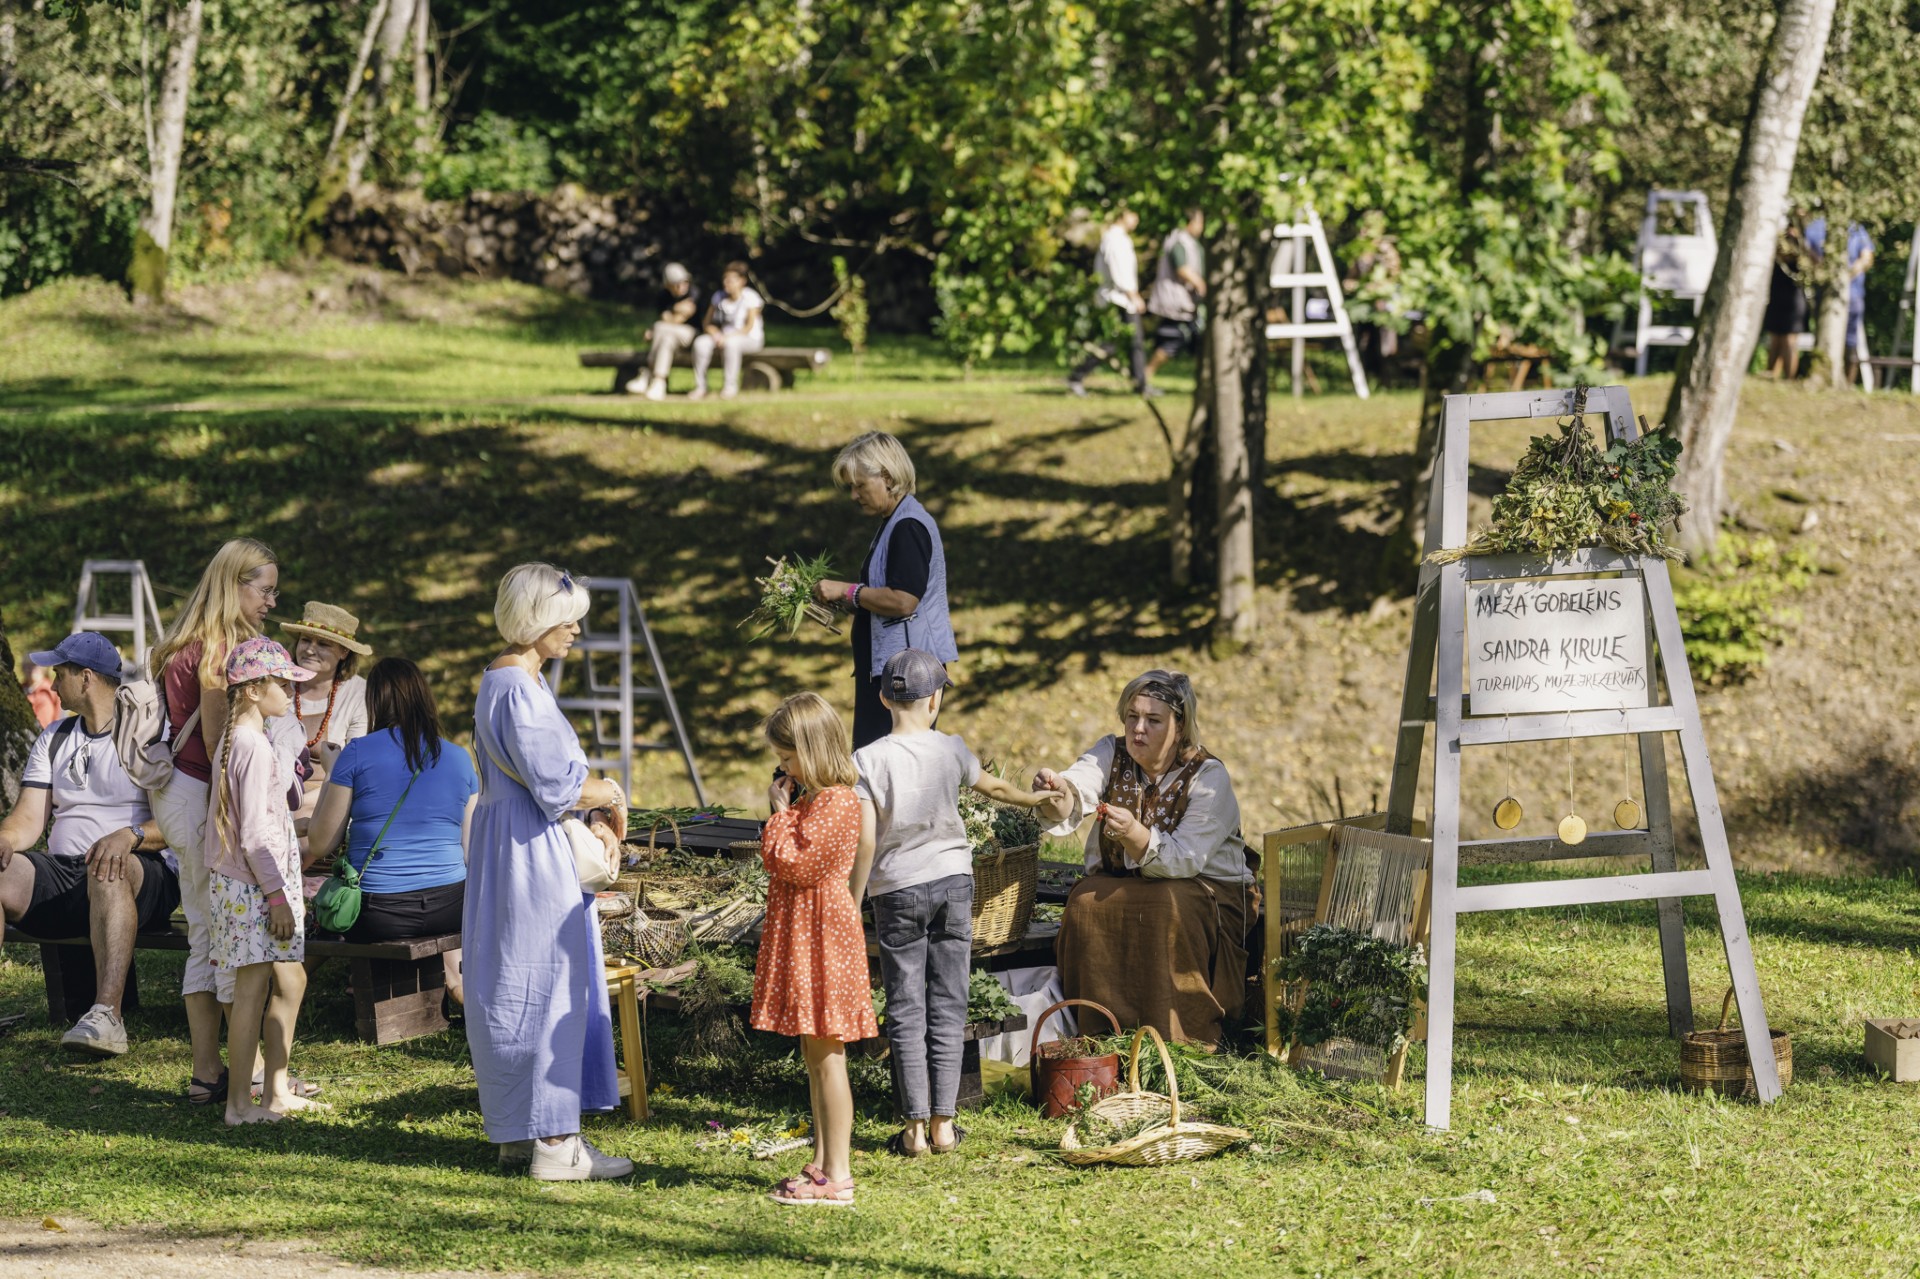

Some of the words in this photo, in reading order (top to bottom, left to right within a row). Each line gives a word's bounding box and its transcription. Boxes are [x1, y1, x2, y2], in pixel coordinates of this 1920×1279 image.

[1477, 588, 1528, 619] MEŽA
[1534, 587, 1622, 616] GOBELĒNS
[1479, 638, 1550, 665] SANDRA
[1560, 635, 1630, 669] ĶIRULE
[1477, 674, 1541, 693] TURAIDAS
